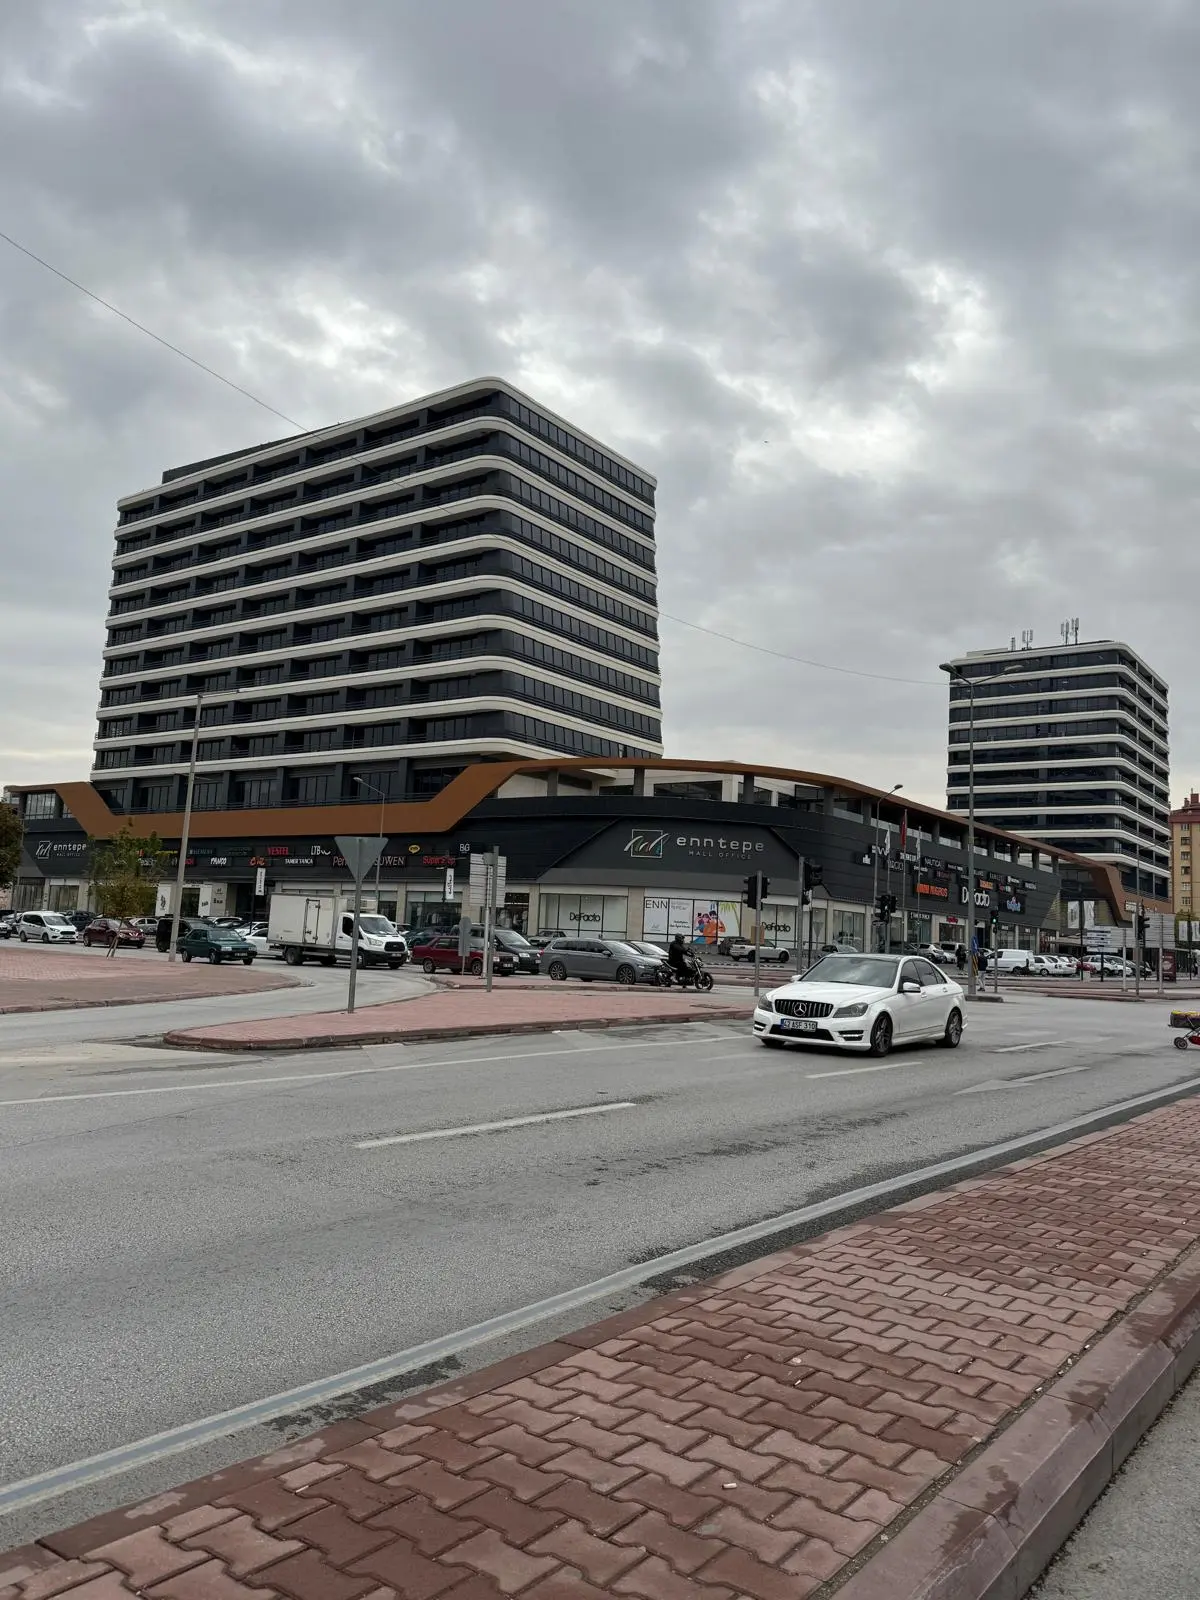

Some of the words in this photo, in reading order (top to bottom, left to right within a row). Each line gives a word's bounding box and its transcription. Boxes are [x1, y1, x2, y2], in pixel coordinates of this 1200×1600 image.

[53, 842, 87, 852] enntepe
[460, 843, 470, 852] BG
[676, 835, 764, 853] enntepe
[311, 845, 321, 856] LTB
[718, 852, 751, 860] OFFICE
[645, 900, 669, 909] ENN
[569, 912, 601, 922] DeFacto
[762, 921, 791, 933] DeFacto
